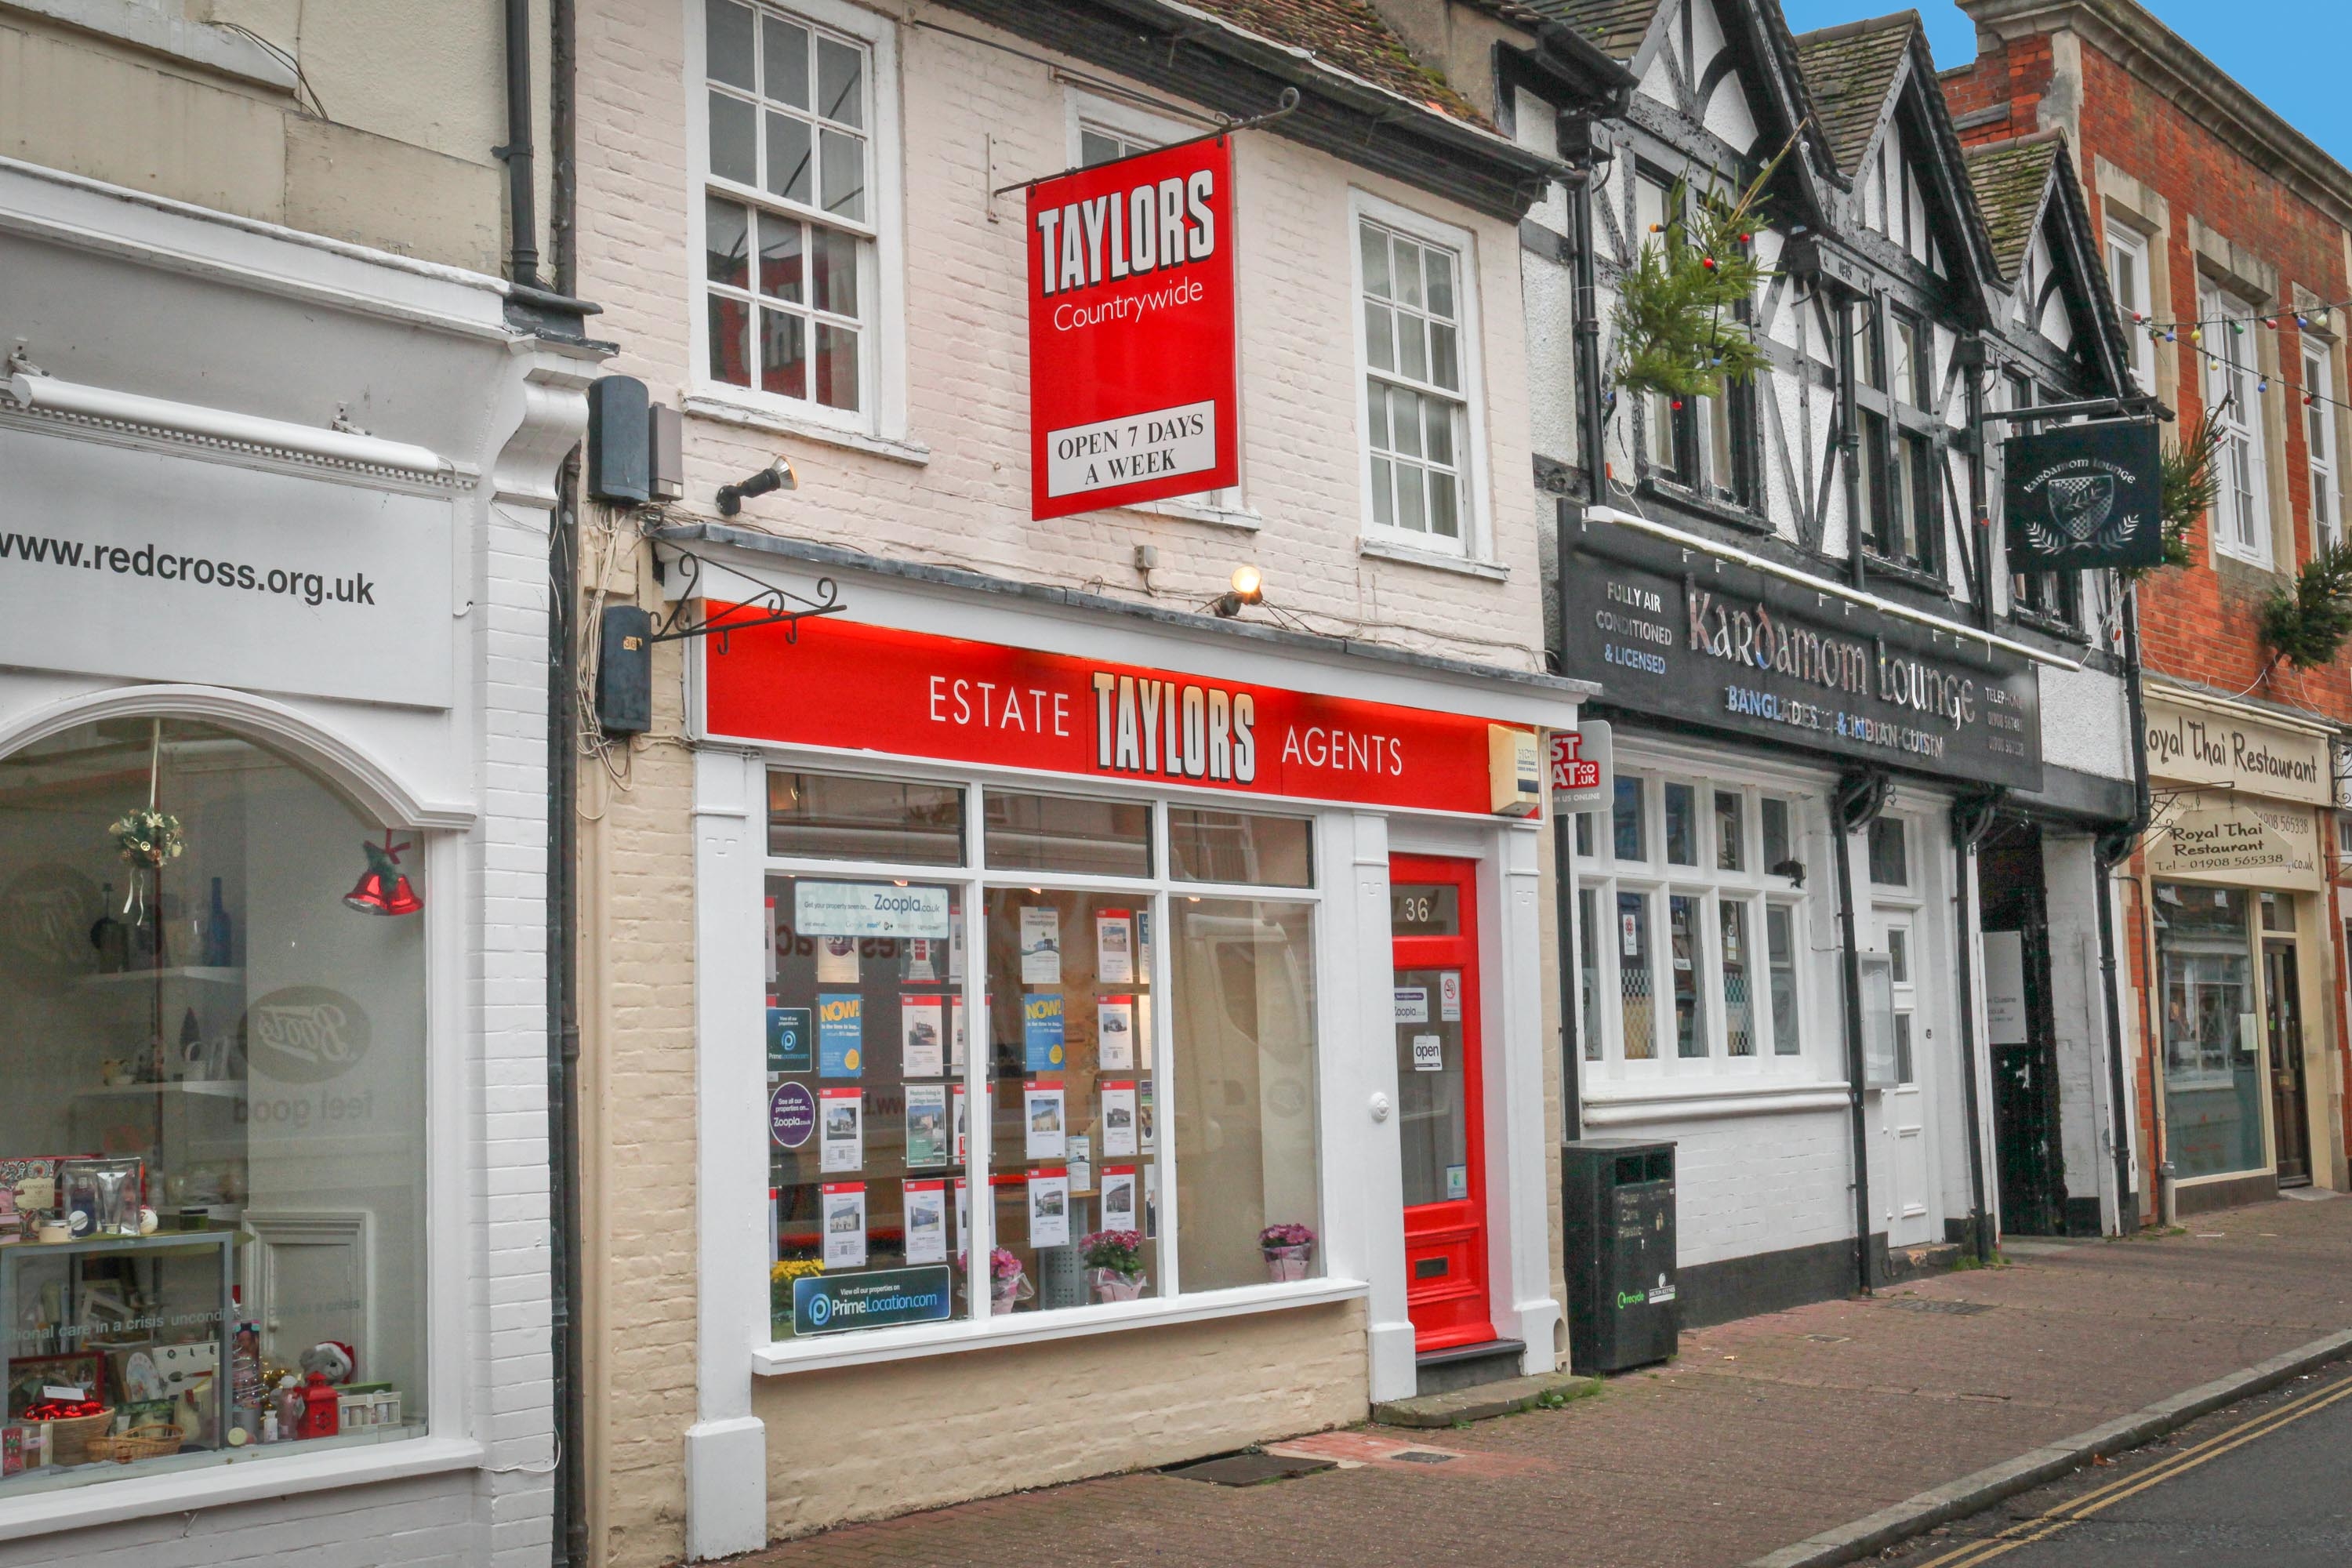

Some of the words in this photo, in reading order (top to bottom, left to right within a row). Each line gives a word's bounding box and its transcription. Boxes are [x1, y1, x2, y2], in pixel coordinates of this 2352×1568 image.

[1036, 169, 1215, 298] TAYLORS
[1054, 277, 1203, 332] Countrywide
[1058, 429, 1120, 460] OPEN
[1127, 426, 1138, 448] 7
[1147, 413, 1204, 445] DAYS
[1085, 464, 1100, 485] A
[1110, 448, 1177, 481] WEEK
[1606, 581, 1641, 607] FULLY
[1643, 591, 1661, 613] AIR
[1595, 610, 1672, 645] CONDITIONED
[1604, 643, 1613, 662] &
[1615, 646, 1666, 674] LICENSED
[929, 675, 1069, 737] ESTATE
[1091, 671, 1255, 785] TAYLORS
[1283, 724, 1403, 776] AGENTS
[1727, 684, 1834, 735] BANGLADESI
[1837, 710, 1847, 736] &
[1849, 713, 1899, 748] INDIAN
[1901, 727, 1946, 760] CUISIN
[1551, 736, 1579, 761] ST
[2146, 716, 2184, 764] oyal
[2187, 720, 2227, 766] Thai
[2233, 730, 2317, 784] Restaurant
[1552, 761, 1580, 787] AT
[1573, 792, 1600, 801] ONLINE
[2172, 824, 2219, 843] Royal
[2223, 822, 2263, 840] Thai
[2281, 815, 2309, 835] 565338
[2172, 840, 2265, 857] Restaurant
[2156, 860, 2176, 871] Tel
[2190, 858, 2230, 869] 01908
[2234, 854, 2283, 866] 565338
[1406, 897, 1428, 922] 36
[820, 999, 860, 1022] NOW!
[1025, 999, 1062, 1020] NOW!
[1415, 1045, 1439, 1060] open
[869, 1286, 893, 1294] properties
[832, 1293, 938, 1316] PrimeLocation.com
[96, 1320, 108, 1333] in
[113, 1321, 122, 1331] a
[125, 1315, 164, 1330] crisis
